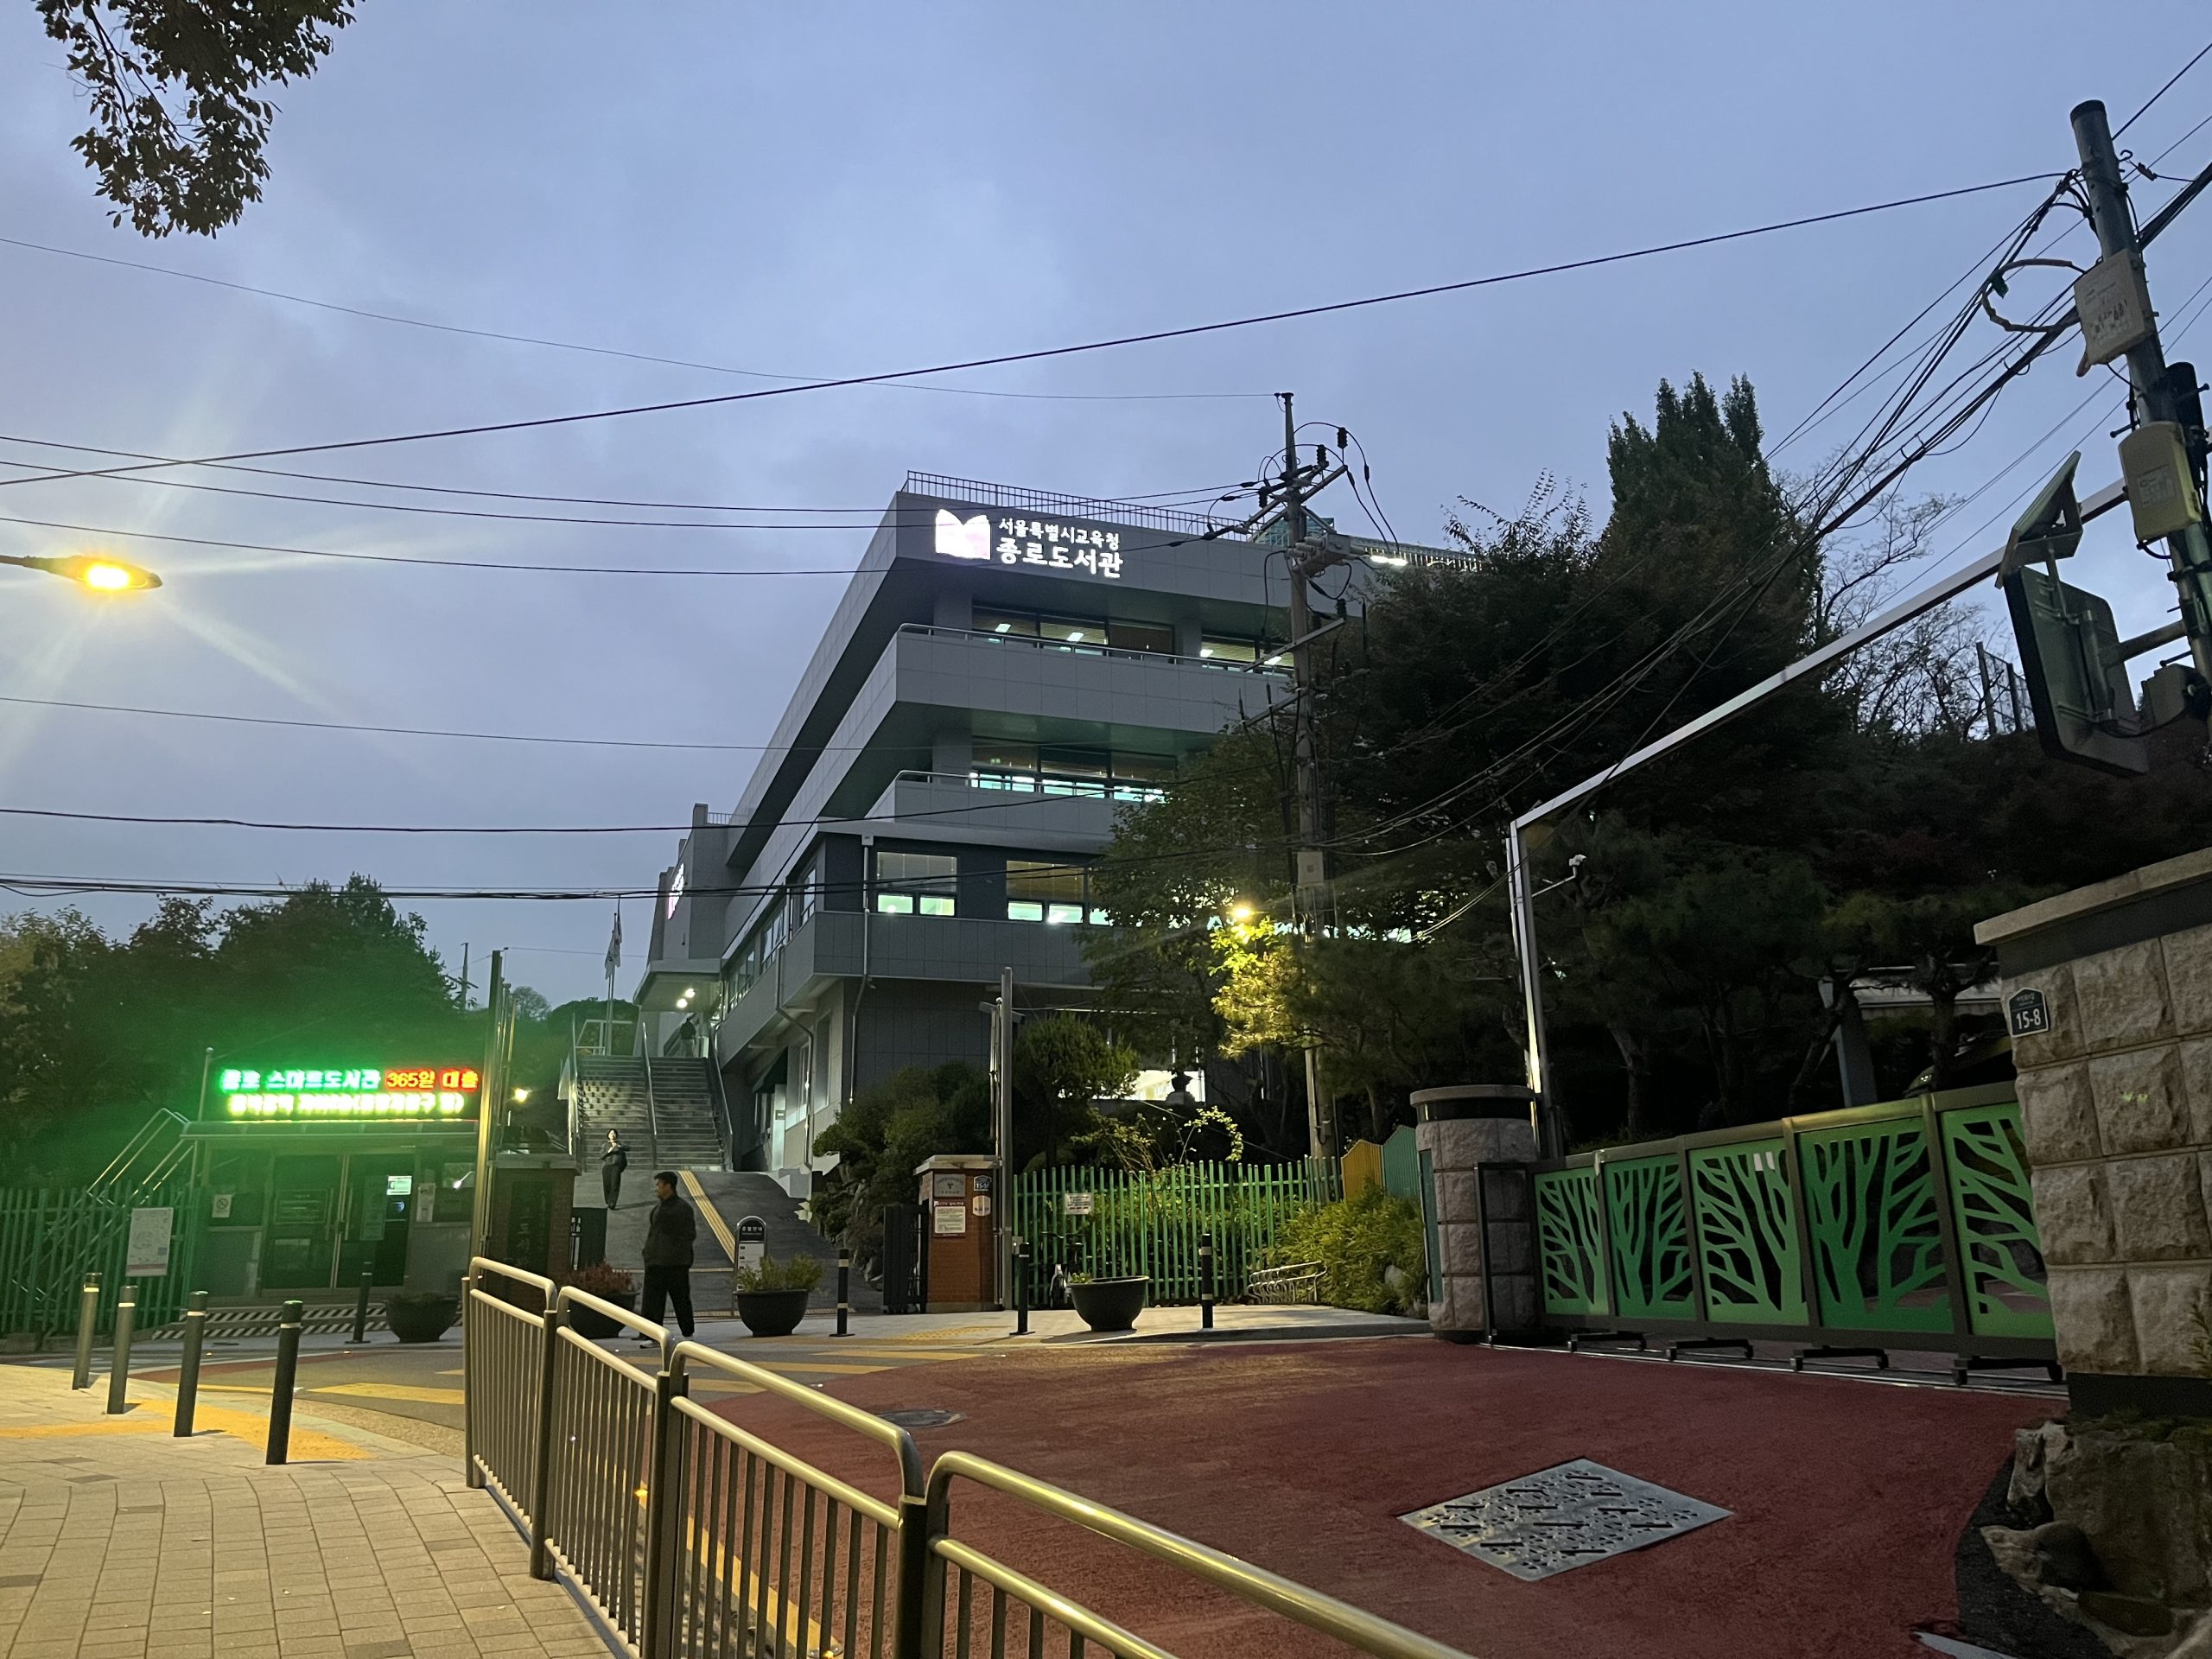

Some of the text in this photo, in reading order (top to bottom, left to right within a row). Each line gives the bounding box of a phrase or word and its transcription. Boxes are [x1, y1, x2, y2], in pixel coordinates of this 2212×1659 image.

[999, 518, 1120, 551] 서울특별시교육청
[996, 537, 1123, 578] 종로도서관
[2016, 1008, 2041, 1029] 15-8
[267, 1070, 381, 1090] 스마트도서관
[386, 1071, 435, 1089] 365일
[442, 1071, 478, 1089] 대출
